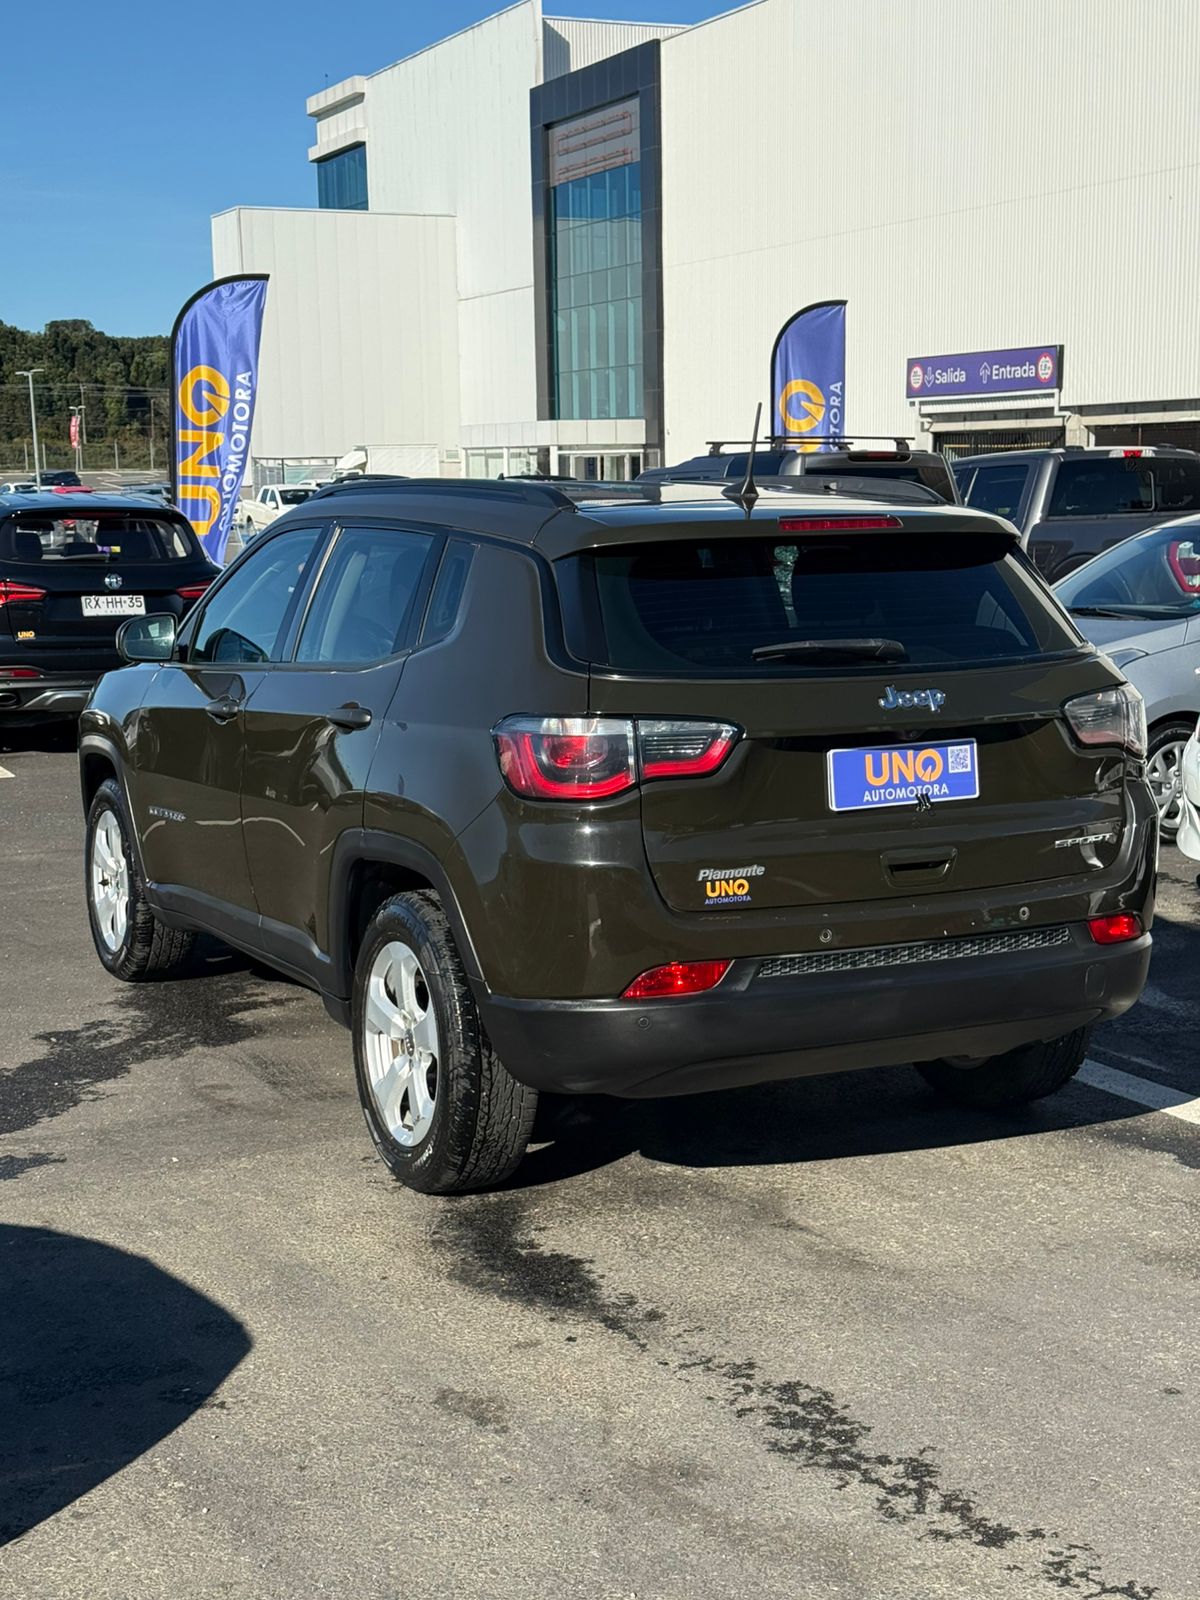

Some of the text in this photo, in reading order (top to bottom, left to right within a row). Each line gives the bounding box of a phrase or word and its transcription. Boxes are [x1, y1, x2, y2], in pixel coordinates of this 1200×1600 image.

[935, 368, 966, 384] Salida
[992, 362, 1036, 380] Entrada
[178, 365, 230, 536] UNO
[878, 686, 946, 712] Jeep
[865, 748, 943, 786] UNO
[863, 784, 949, 802] AUTOMOTORA
[697, 864, 765, 881] Piamonte
[706, 879, 749, 897] UNO
